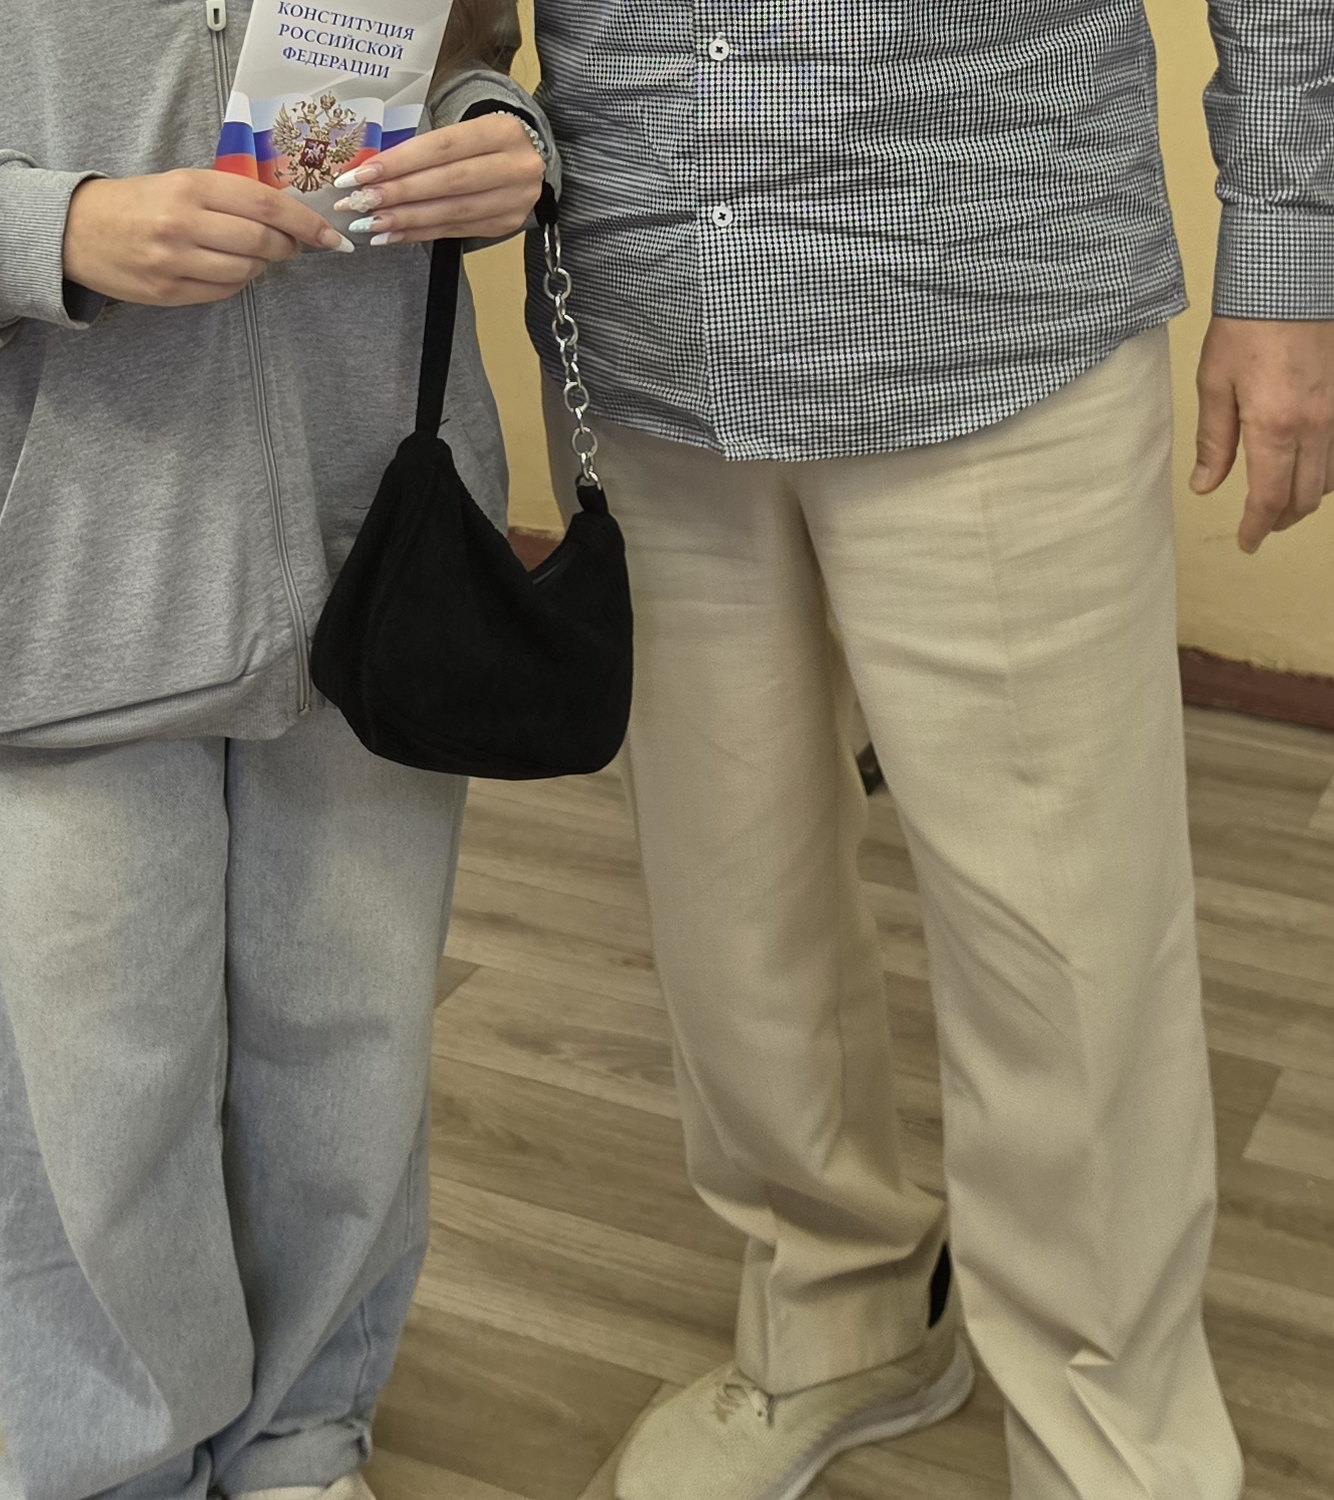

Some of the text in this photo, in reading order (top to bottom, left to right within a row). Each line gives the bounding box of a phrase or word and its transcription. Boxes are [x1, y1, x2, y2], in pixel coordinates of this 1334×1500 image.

[277, 1, 415, 41] КОНСТИТУЦИЯ
[278, 23, 404, 60] РОССИЙСКОЙ
[282, 46, 390, 79] ФЕДЕРАЦИИ
